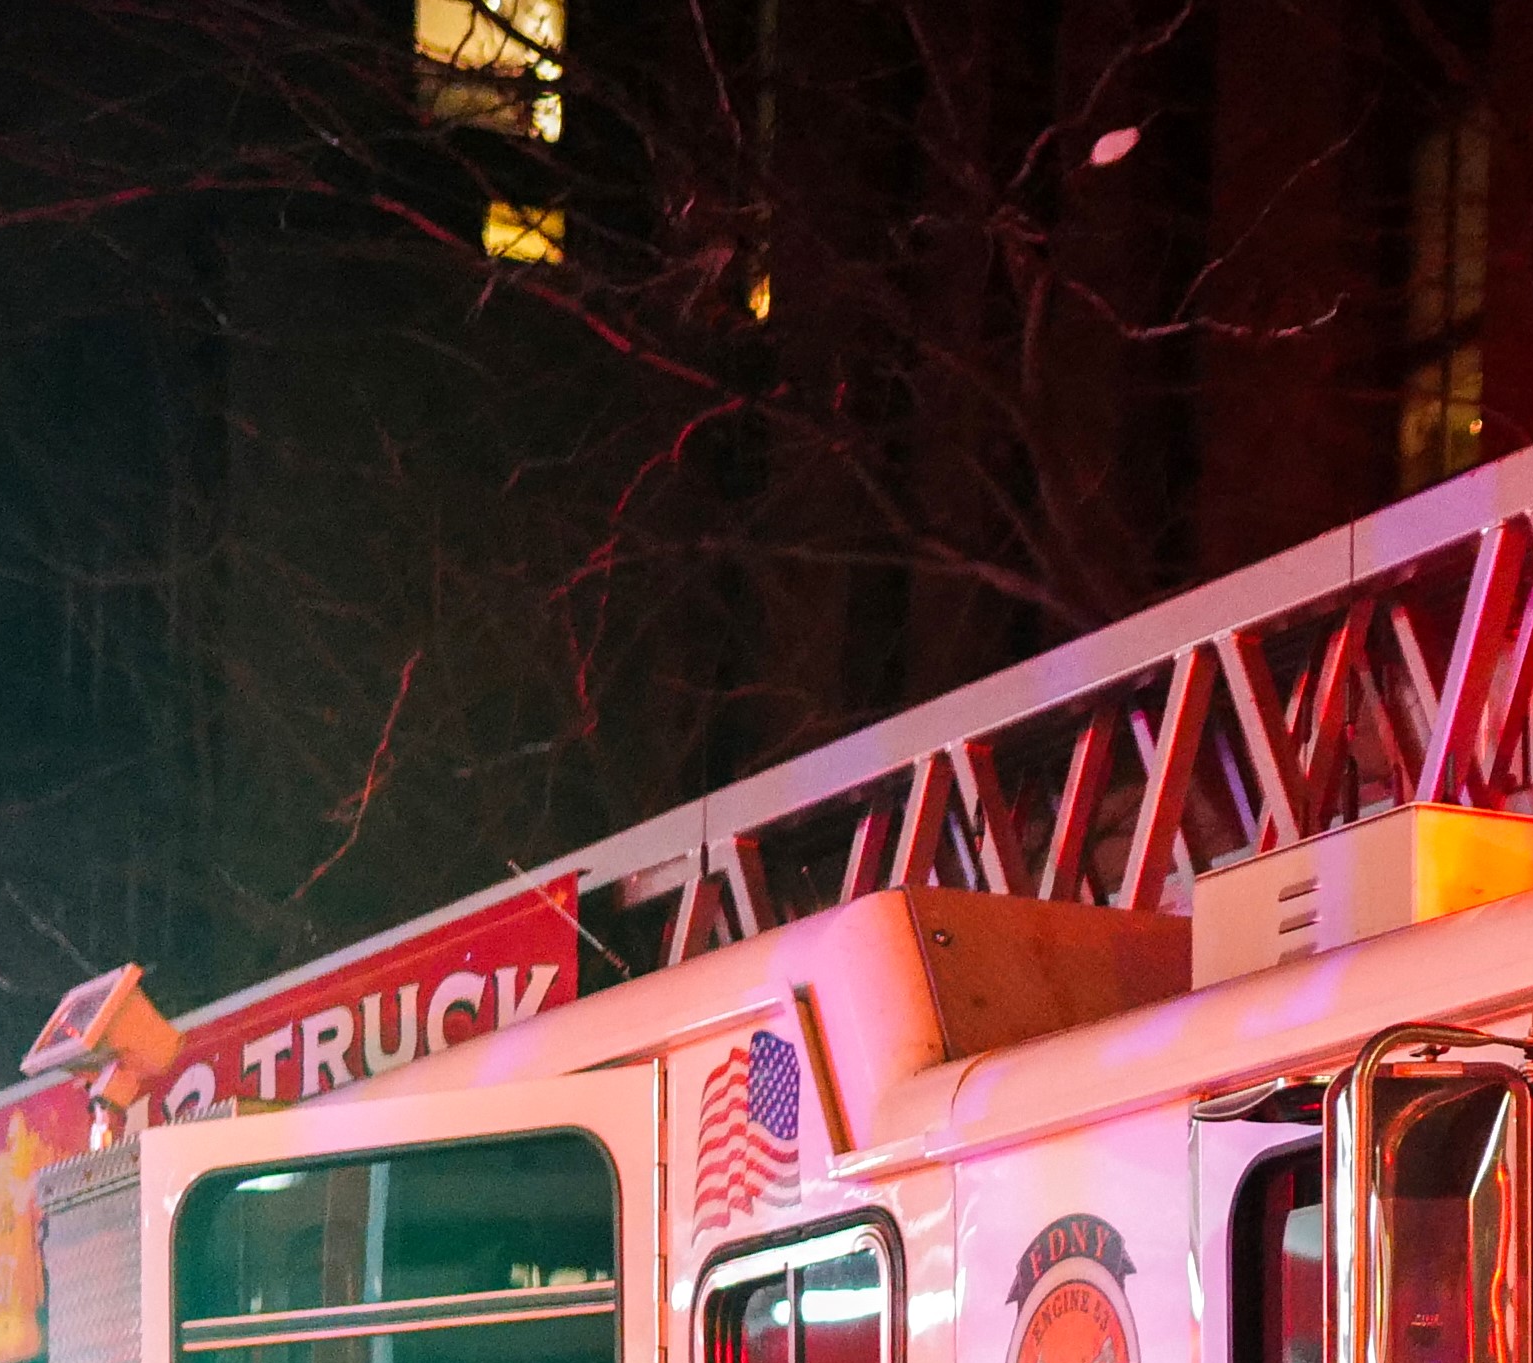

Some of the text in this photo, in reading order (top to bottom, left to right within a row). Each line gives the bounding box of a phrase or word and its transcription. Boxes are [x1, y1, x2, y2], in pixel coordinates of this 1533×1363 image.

[243, 964, 560, 1100] TRUCK
[1029, 1221, 1110, 1279] FDNY
[1032, 1289, 1090, 1346] ENGINE
